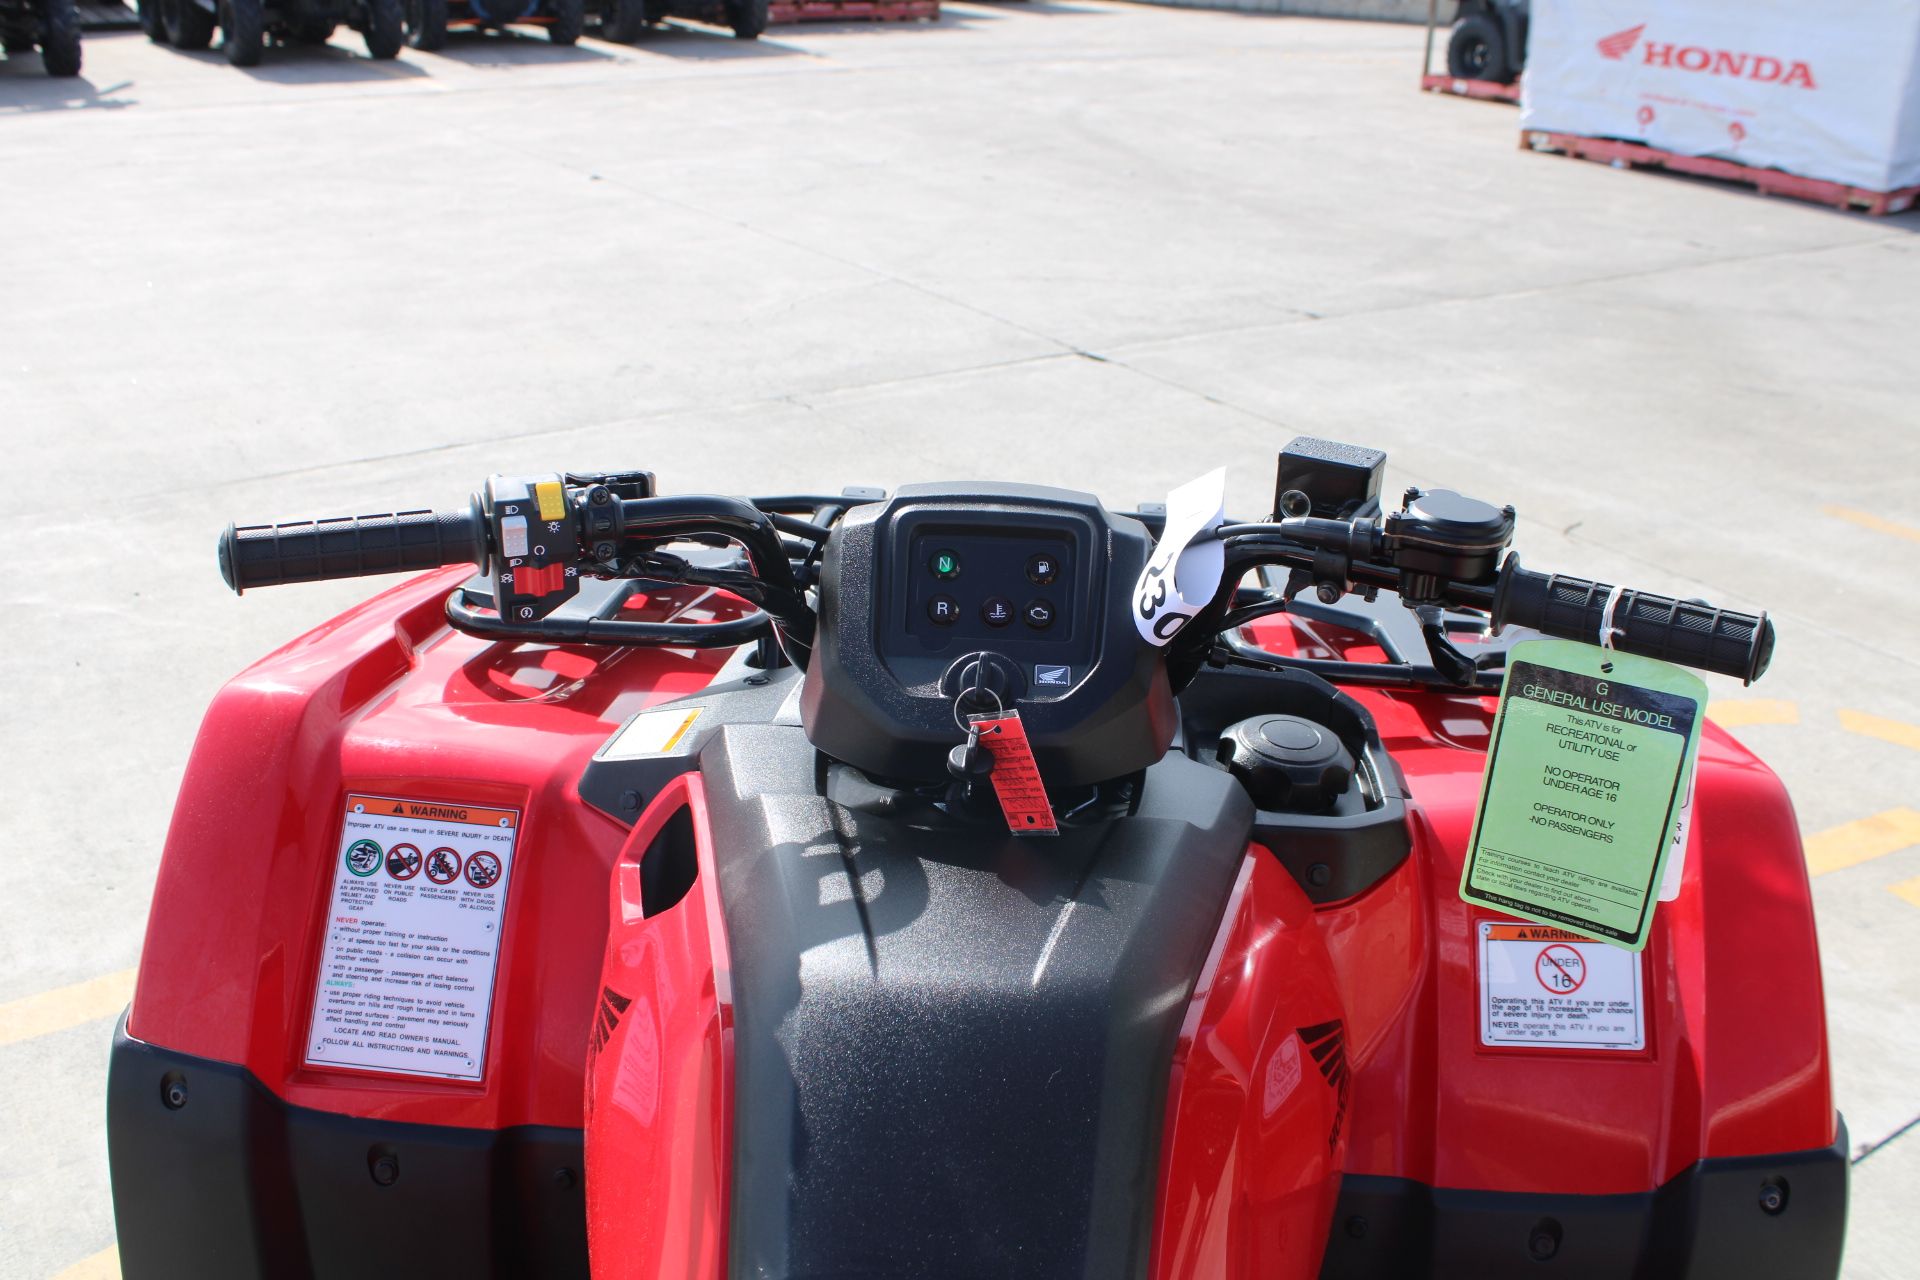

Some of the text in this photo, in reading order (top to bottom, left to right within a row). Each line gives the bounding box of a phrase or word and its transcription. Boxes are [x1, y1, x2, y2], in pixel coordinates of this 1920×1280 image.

[1643, 41, 1817, 89] HONDA
[938, 557, 950, 570] N
[937, 602, 948, 614] R
[1596, 682, 1608, 695] G
[1522, 684, 1675, 729] GENERAL USE MODEL
[1567, 714, 1622, 734] This ATV is for
[1546, 722, 1637, 752] RECREATIONAL or
[1558, 738, 1620, 762] UTILITY USE
[1544, 764, 1620, 791] NO OPERATOR
[1542, 776, 1617, 802] UNDER AGE 16
[410, 805, 467, 820] WARNING
[1533, 802, 1615, 829] OPERATOR ONLY
[436, 829, 459, 837] SEVERE
[1547, 819, 1613, 843] PASSENGERS
[383, 930, 406, 939] training
[417, 934, 448, 942] instruction
[1542, 958, 1580, 968] UNDER
[1552, 973, 1573, 988] 16
[1491, 996, 1527, 1005] Operating
[1529, 998, 1545, 1006] this
[1522, 1003, 1531, 1011] of
[1530, 1011, 1552, 1019] injury
[333, 1027, 359, 1035] LOCATE
[399, 1033, 429, 1042] OWNER'S
[1527, 1028, 1544, 1036] age
[322, 1037, 349, 1046] FOLLOW
[367, 1042, 414, 1052] INSTRUCTIONS
